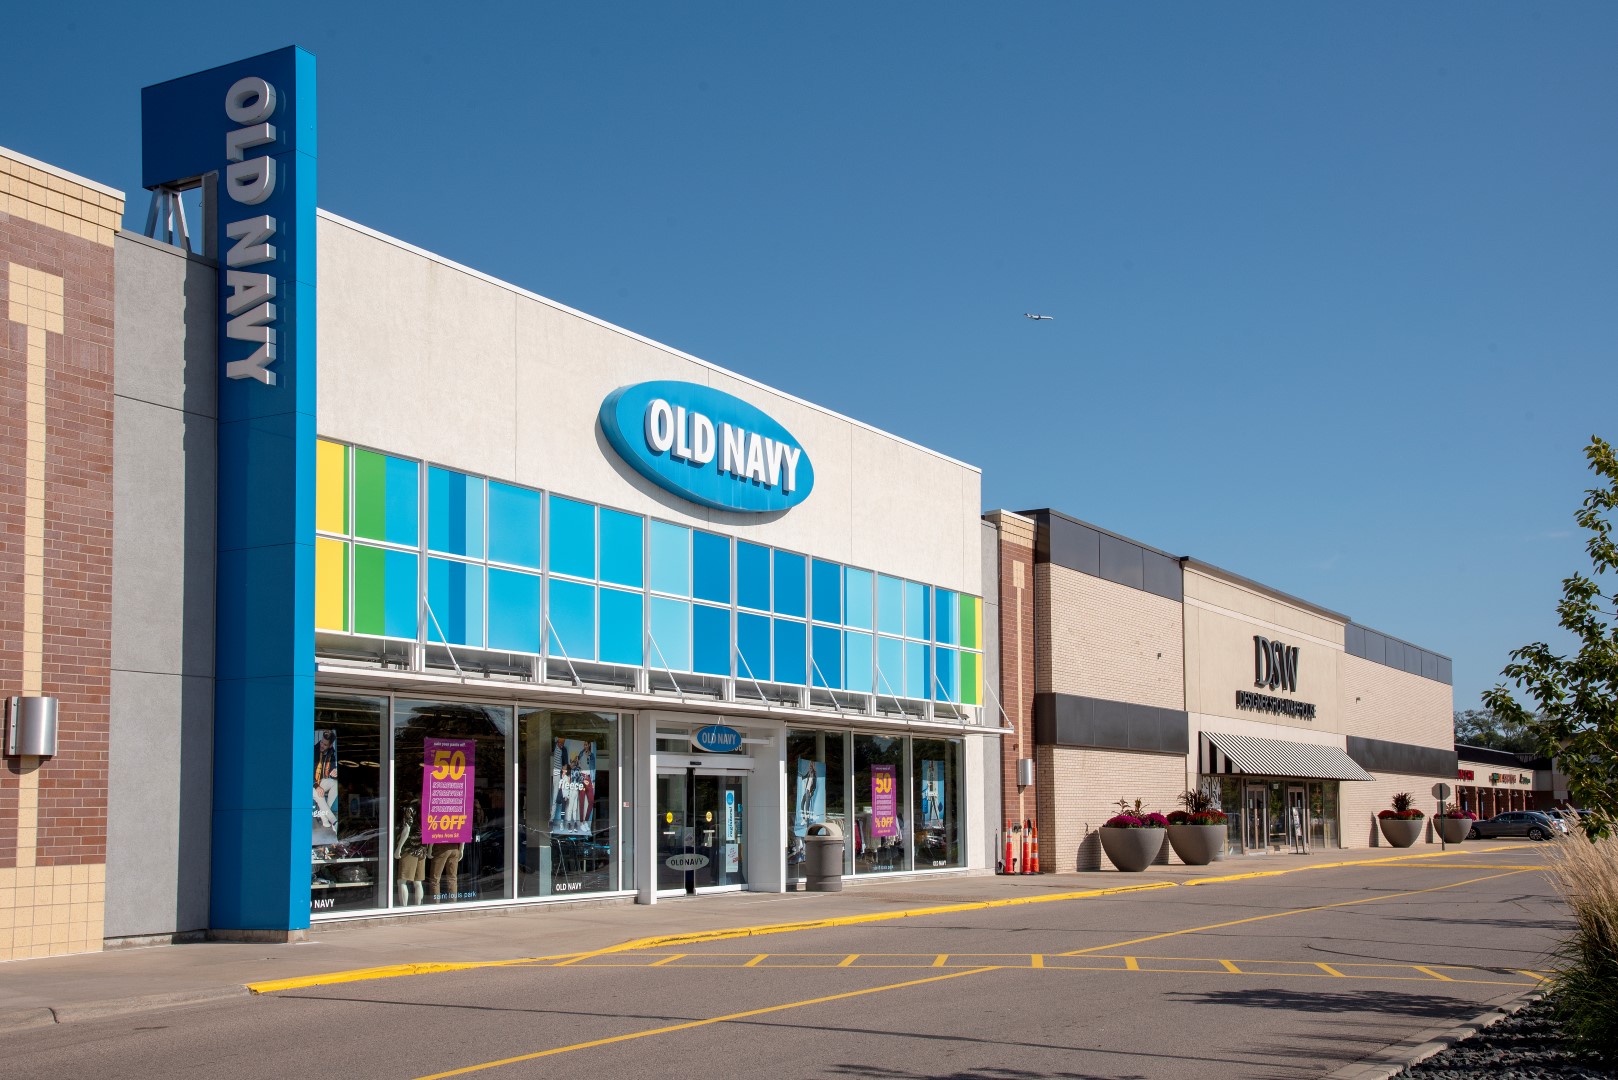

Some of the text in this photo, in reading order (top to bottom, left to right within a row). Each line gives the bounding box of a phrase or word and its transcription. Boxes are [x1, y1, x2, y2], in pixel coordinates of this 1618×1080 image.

[225, 76, 277, 386] OLD NAVY
[644, 398, 801, 492] OLD NAVY
[1253, 635, 1300, 694] DSW
[701, 732, 737, 745] OLD NAVY
[432, 750, 466, 781] 50
[876, 773, 892, 793] 50
[312, 809, 328, 818] gger
[439, 815, 467, 830] OFF
[881, 817, 894, 828] OFF
[684, 858, 704, 866] NAVY
[555, 882, 582, 892] OLD NAVY
[314, 898, 335, 909] NAVY
